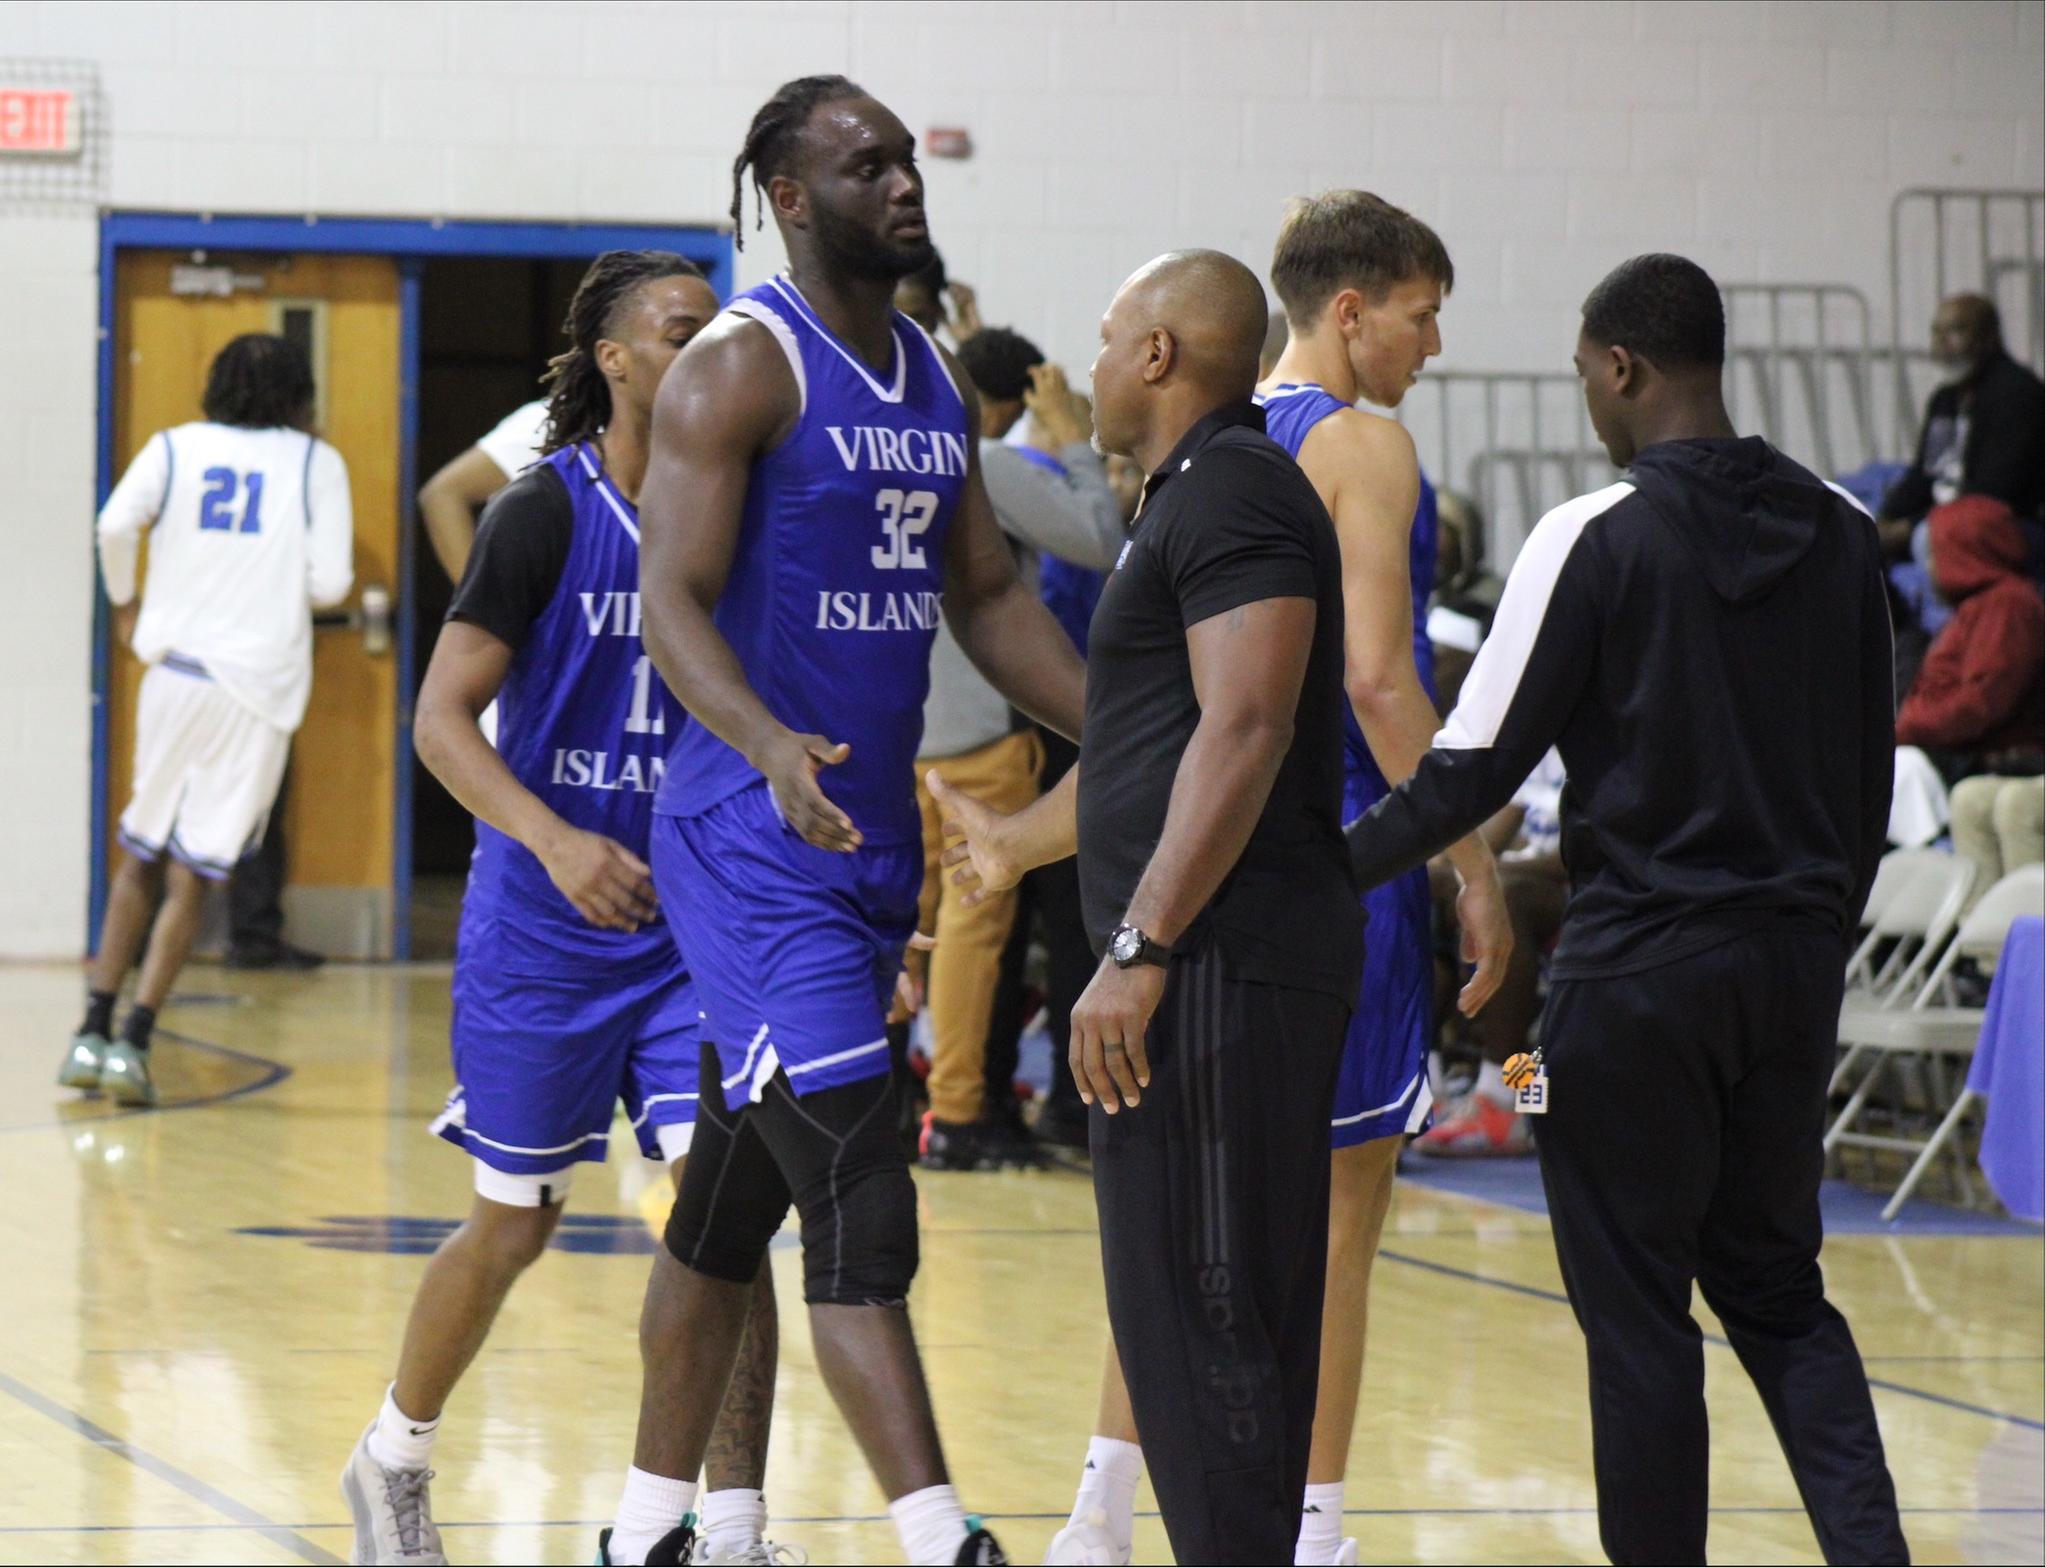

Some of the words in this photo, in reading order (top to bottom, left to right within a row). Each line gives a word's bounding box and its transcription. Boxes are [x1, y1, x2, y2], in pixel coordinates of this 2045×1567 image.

[825, 426, 967, 477] VIRGIN
[200, 466, 264, 533] 21
[871, 489, 939, 570] 32
[1520, 1084, 1543, 1105] 23
[1199, 1265, 1260, 1444] adias
